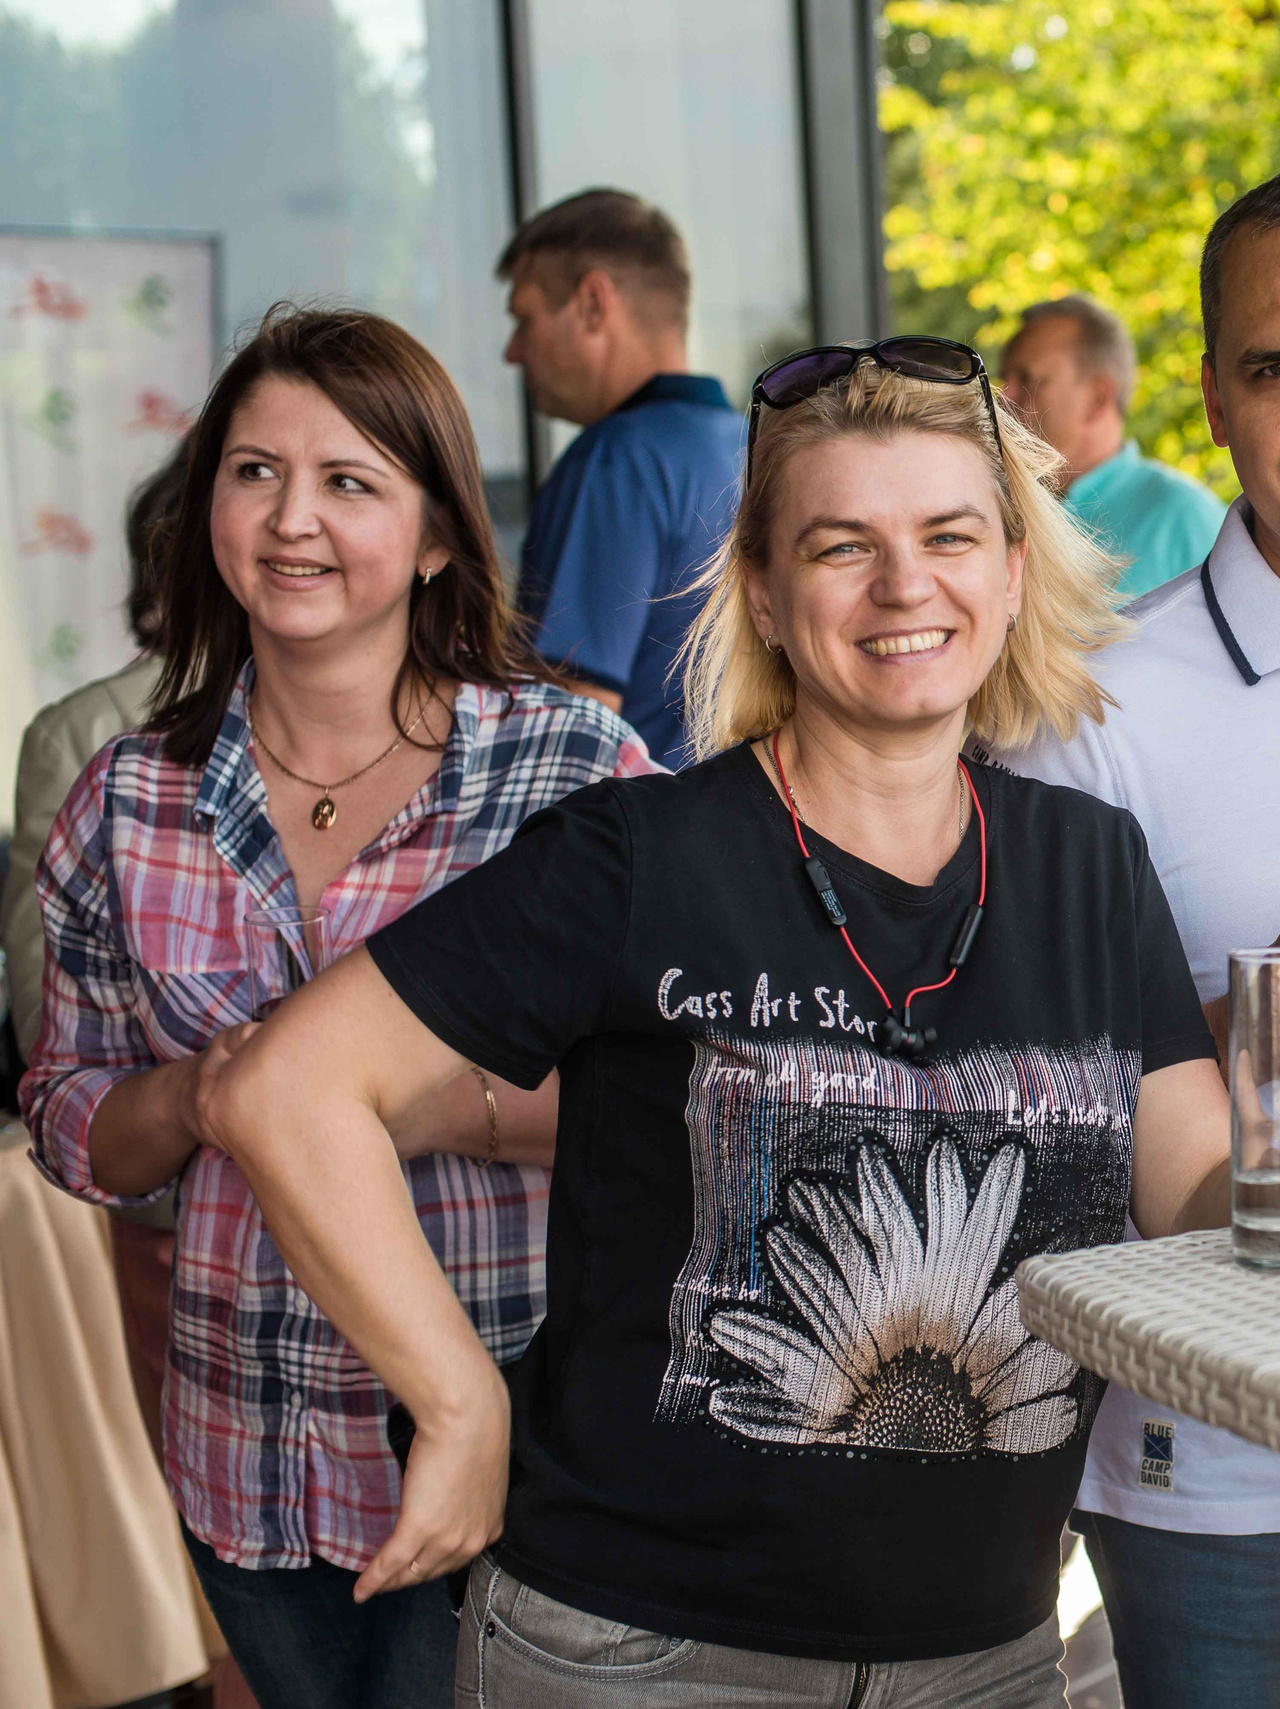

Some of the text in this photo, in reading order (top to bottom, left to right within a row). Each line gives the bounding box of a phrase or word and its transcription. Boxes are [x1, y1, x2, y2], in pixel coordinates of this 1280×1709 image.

[658, 967, 878, 1042] Cass Art Stor
[1144, 1422, 1172, 1438] BLUE
[1141, 1459, 1171, 1474] CAMP
[1140, 1471, 1170, 1487] DAVID
